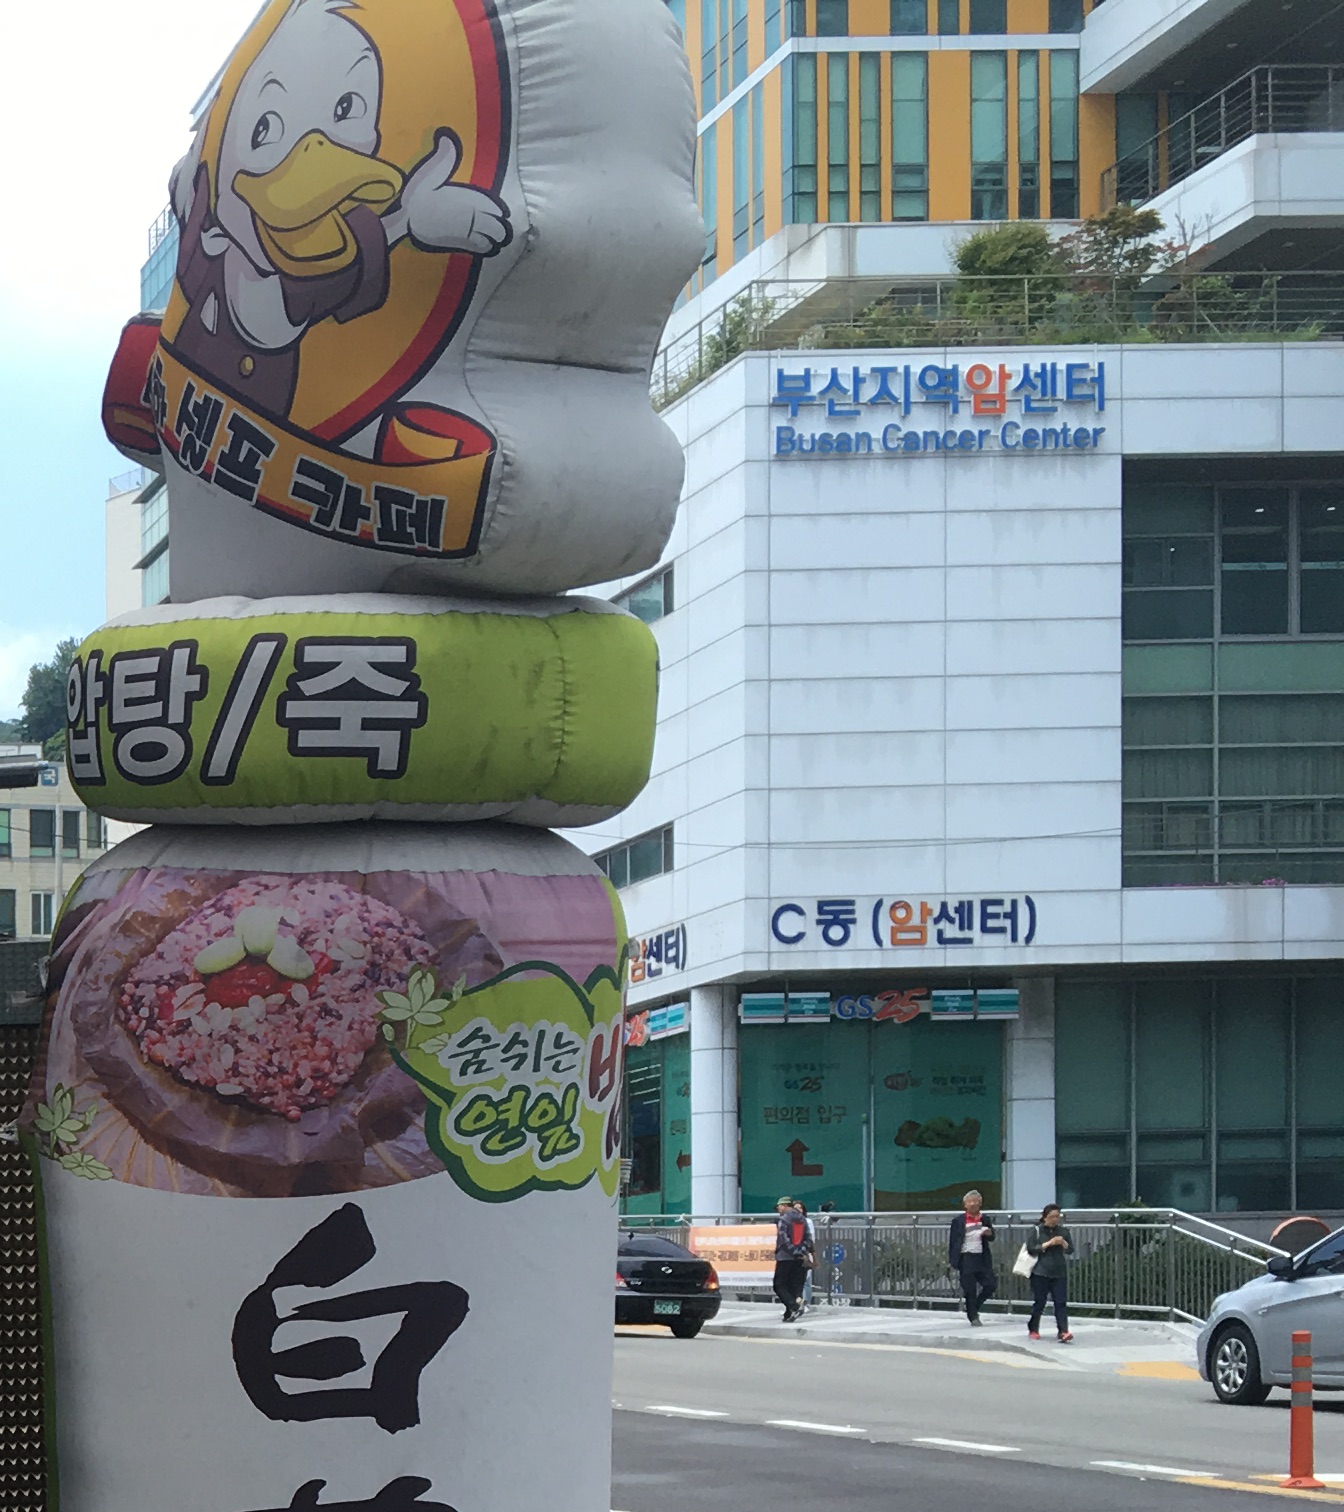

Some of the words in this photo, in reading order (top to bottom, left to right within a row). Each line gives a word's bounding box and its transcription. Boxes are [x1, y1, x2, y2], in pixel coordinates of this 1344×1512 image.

[772, 361, 1106, 419] 부산지역암센터
[774, 425, 874, 456] Busan
[881, 422, 991, 454] Cancer
[1000, 420, 1107, 452] Center
[289, 454, 448, 552] 카페
[771, 898, 857, 947] C동
[872, 895, 1037, 947] (암센터)
[836, 988, 928, 1024] GS25
[448, 1026, 580, 1078] 숨쉬는
[454, 1082, 580, 1162] 연잎
[764, 1105, 810, 1124] 편의점
[817, 1104, 849, 1124] 입구
